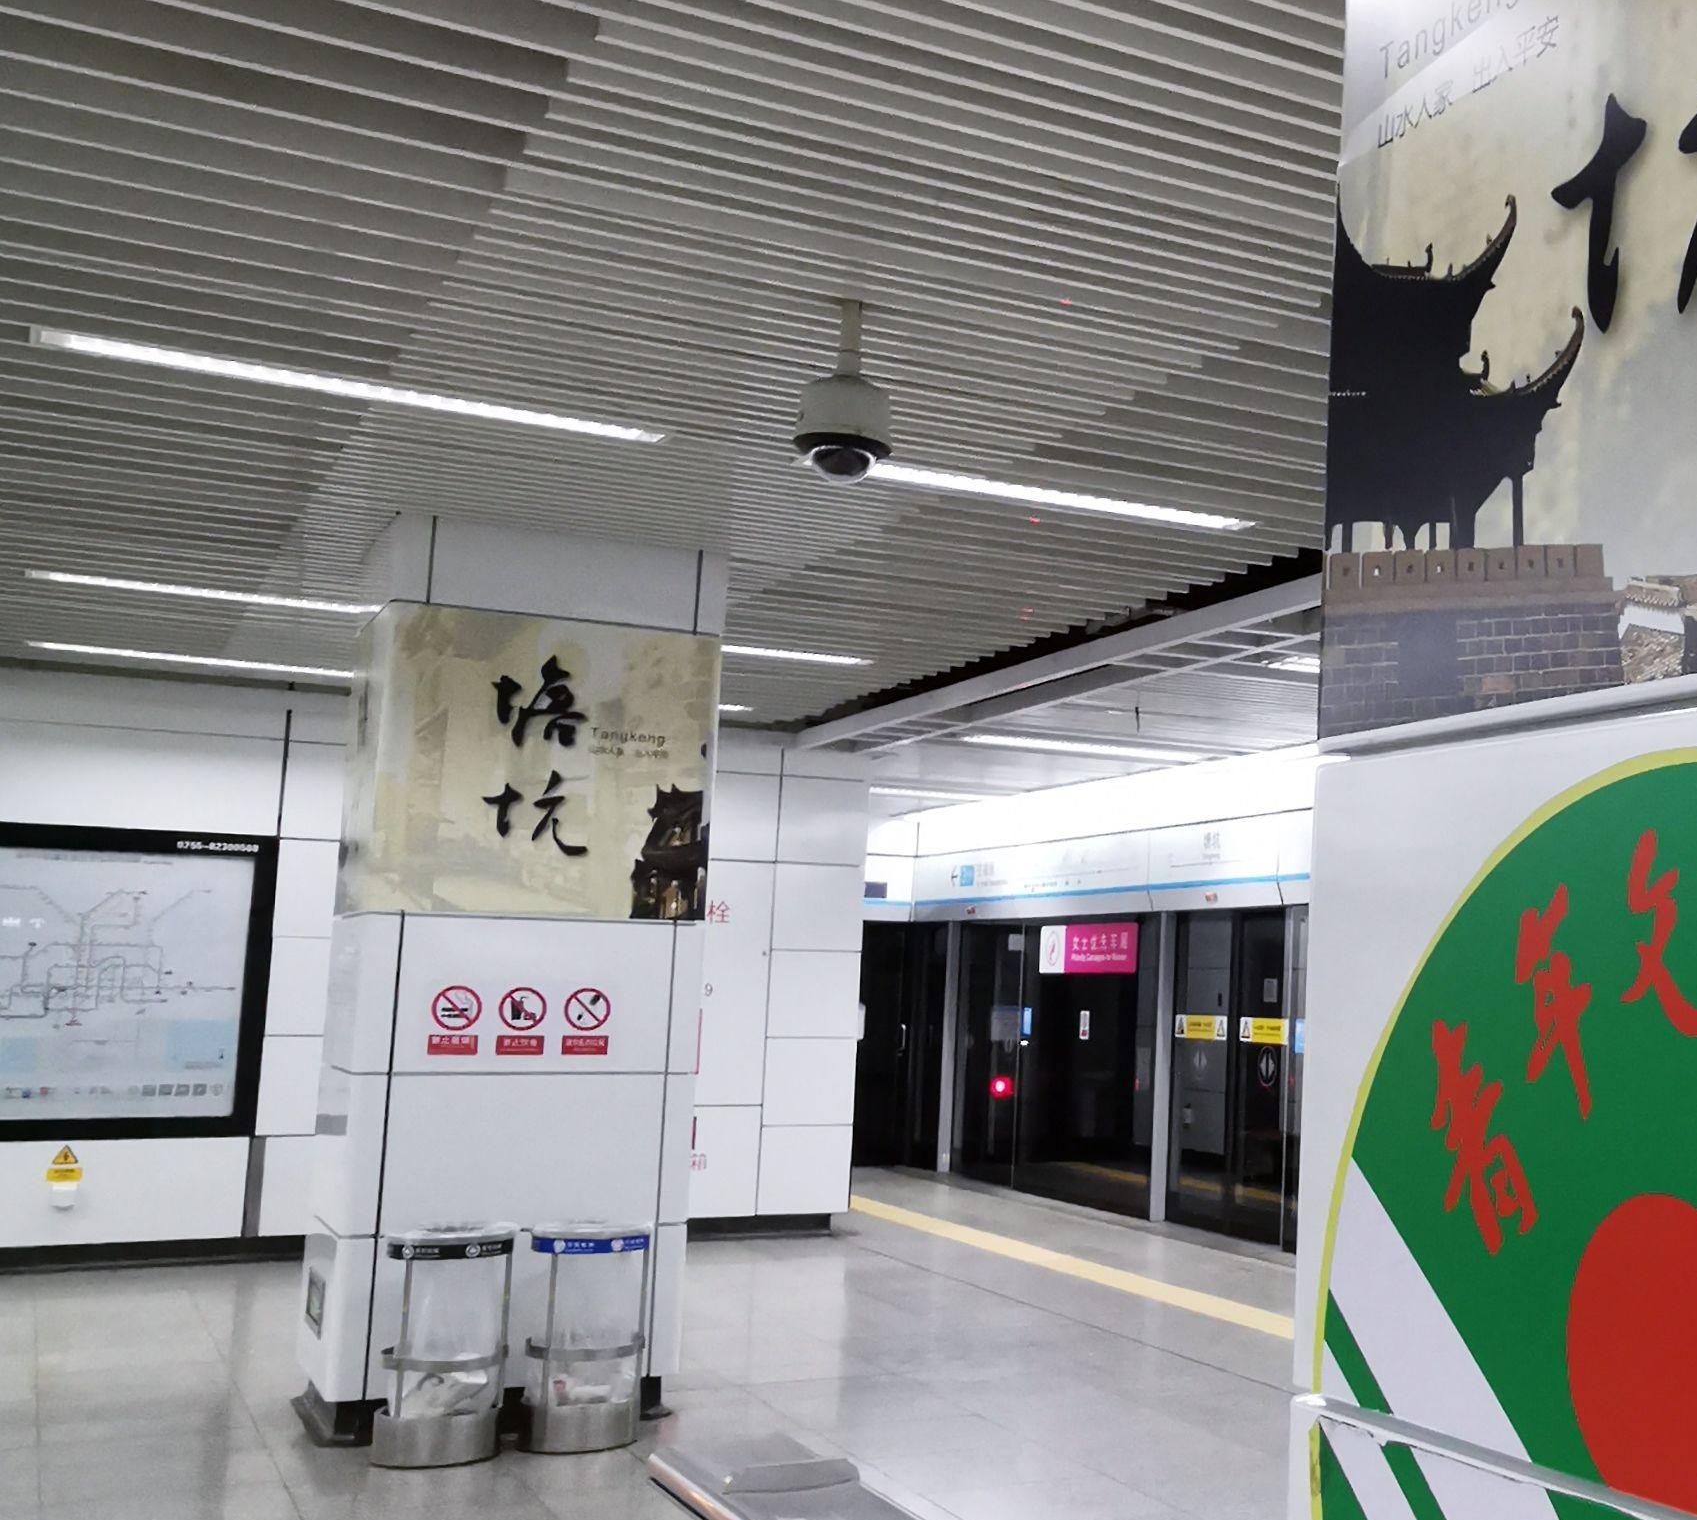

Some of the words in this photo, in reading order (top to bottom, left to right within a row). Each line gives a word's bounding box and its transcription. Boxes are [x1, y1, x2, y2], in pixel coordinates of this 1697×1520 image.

[1377, 79, 1454, 149] 山水人家
[1471, 15, 1560, 94] 出入平安
[482, 655, 588, 856] 塘坑
